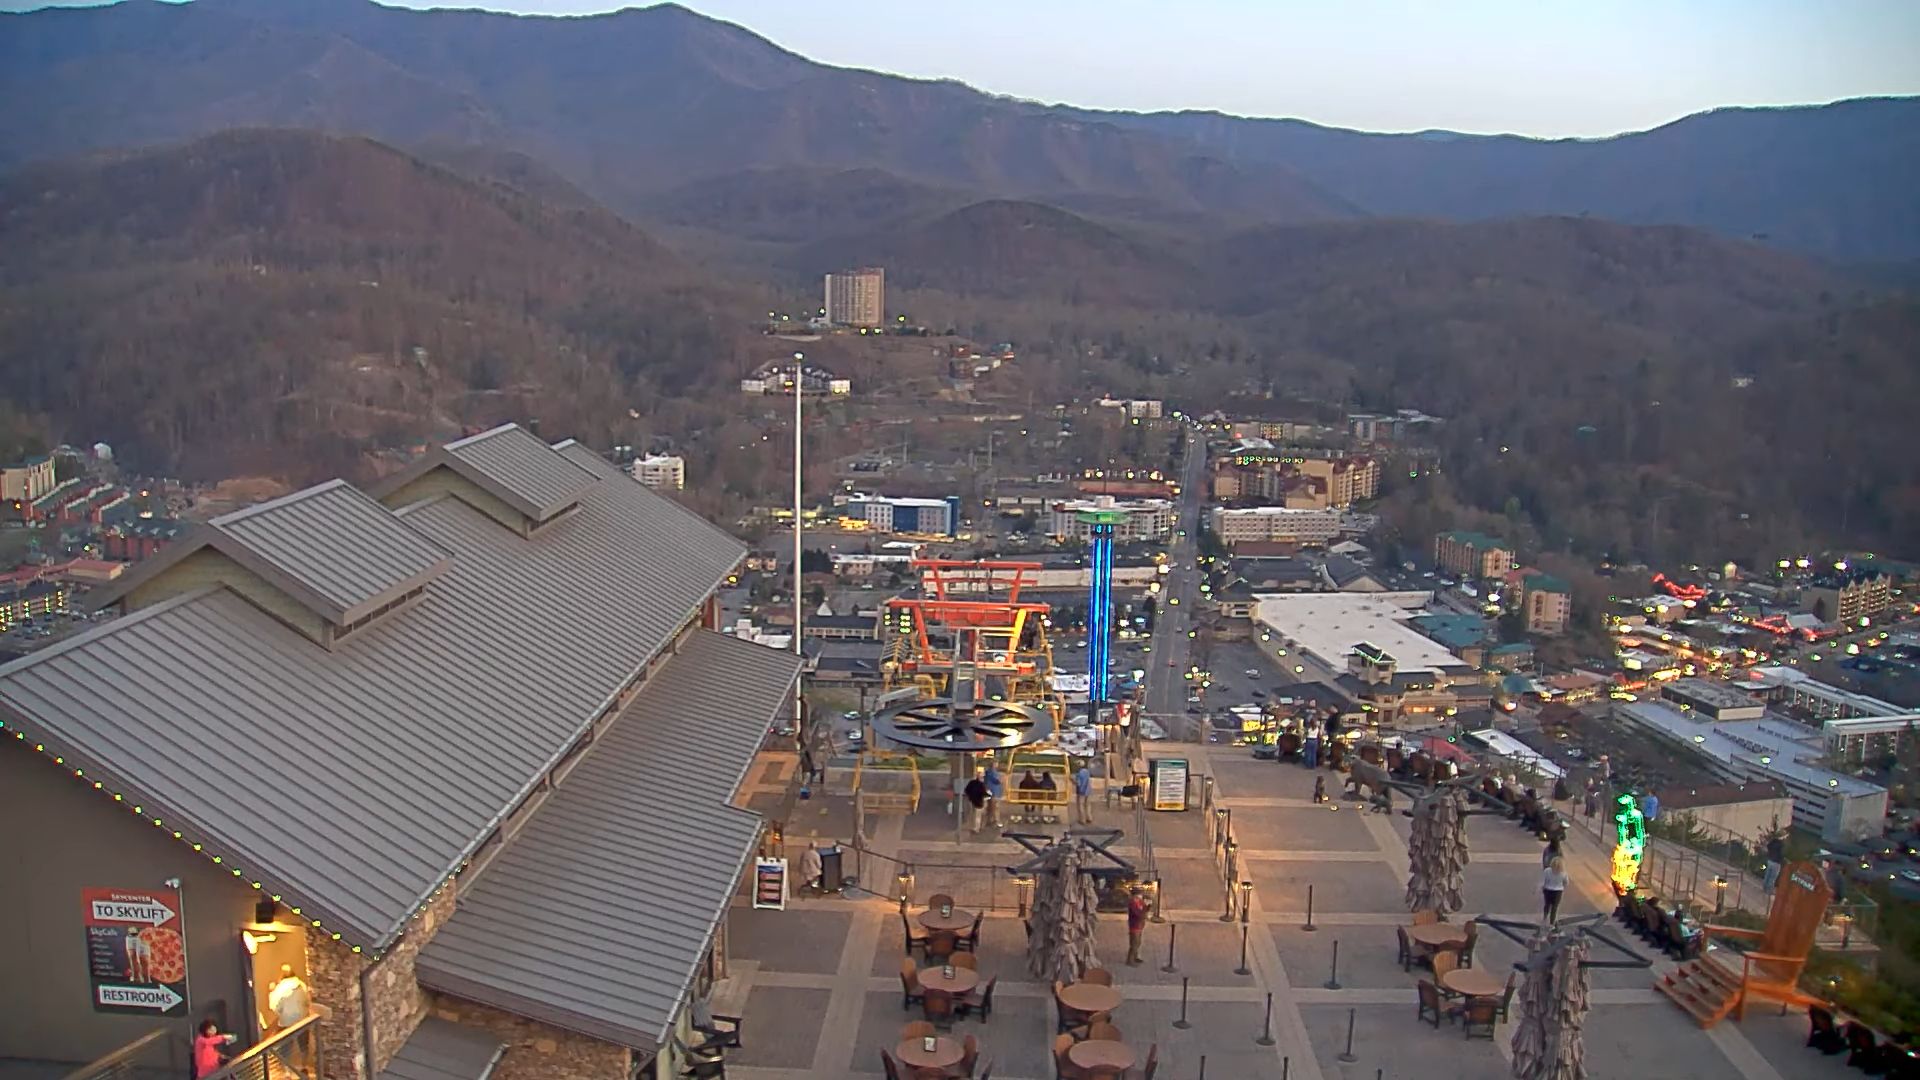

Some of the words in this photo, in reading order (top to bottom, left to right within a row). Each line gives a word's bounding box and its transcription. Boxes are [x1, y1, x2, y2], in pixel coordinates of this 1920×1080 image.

[96, 905, 113, 917] TO
[117, 906, 166, 920] SKYLIFT
[103, 990, 172, 1004] RESTROOMS
